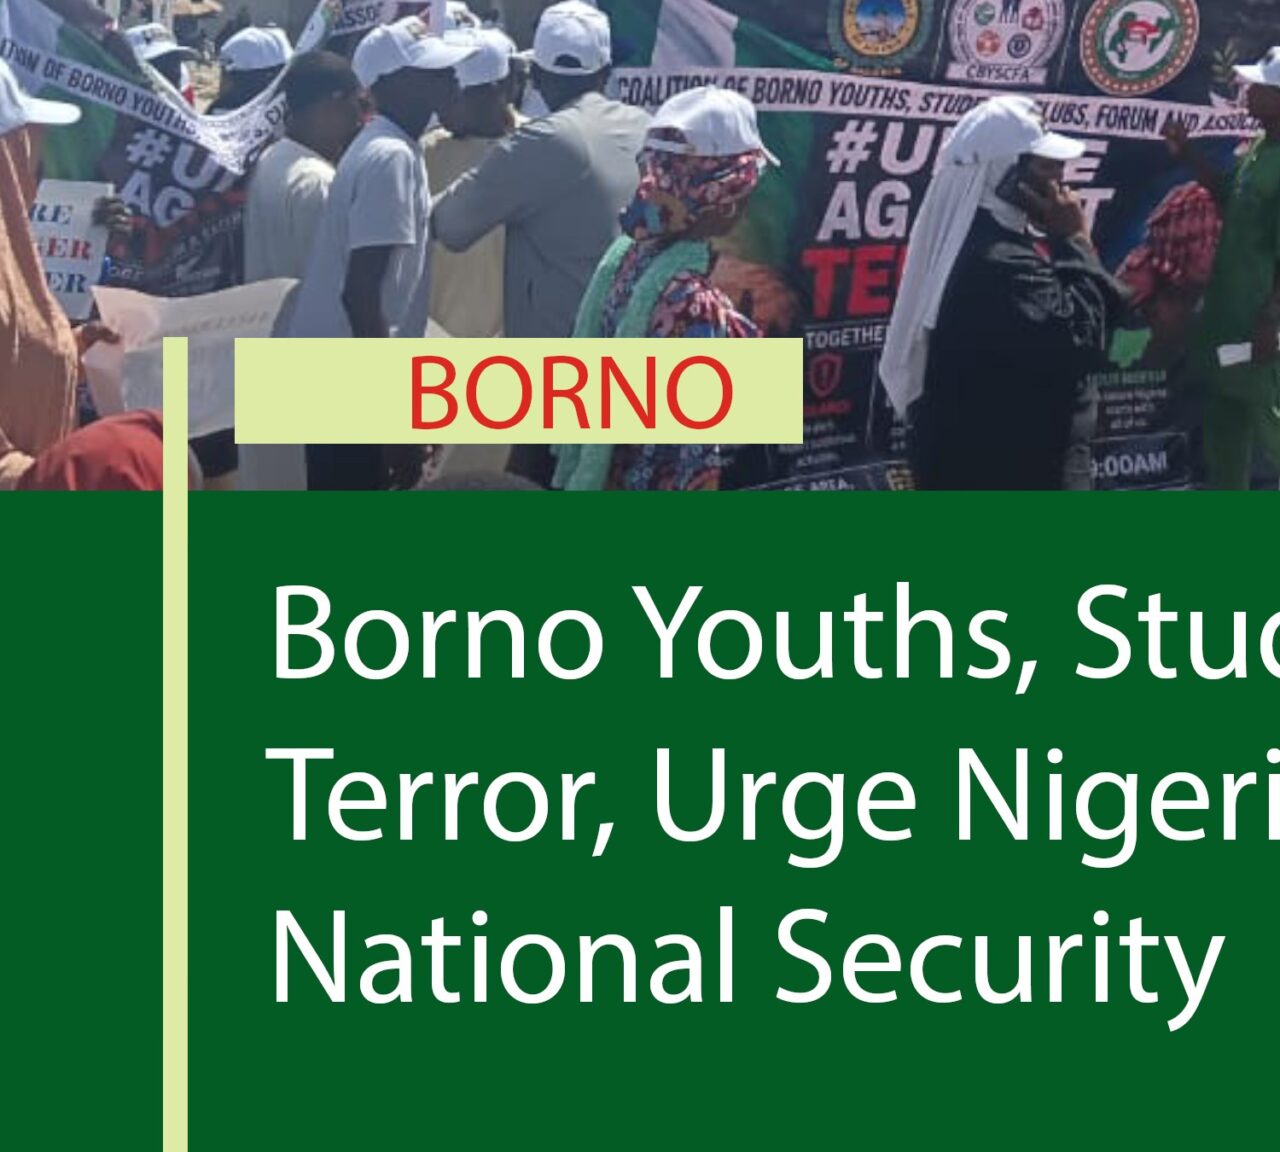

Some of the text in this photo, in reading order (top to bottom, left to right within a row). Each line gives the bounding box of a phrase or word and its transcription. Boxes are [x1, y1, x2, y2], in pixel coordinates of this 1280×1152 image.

[43, 57, 67, 81] OF
[67, 68, 128, 106] BORNO
[751, 76, 823, 105] BORNO
[828, 80, 912, 113] YOUTHS,
[918, 91, 990, 115] STUD
[1034, 100, 1091, 127] LUBS,
[1096, 104, 1159, 133] FORUM
[805, 325, 889, 350] TOGETHE
